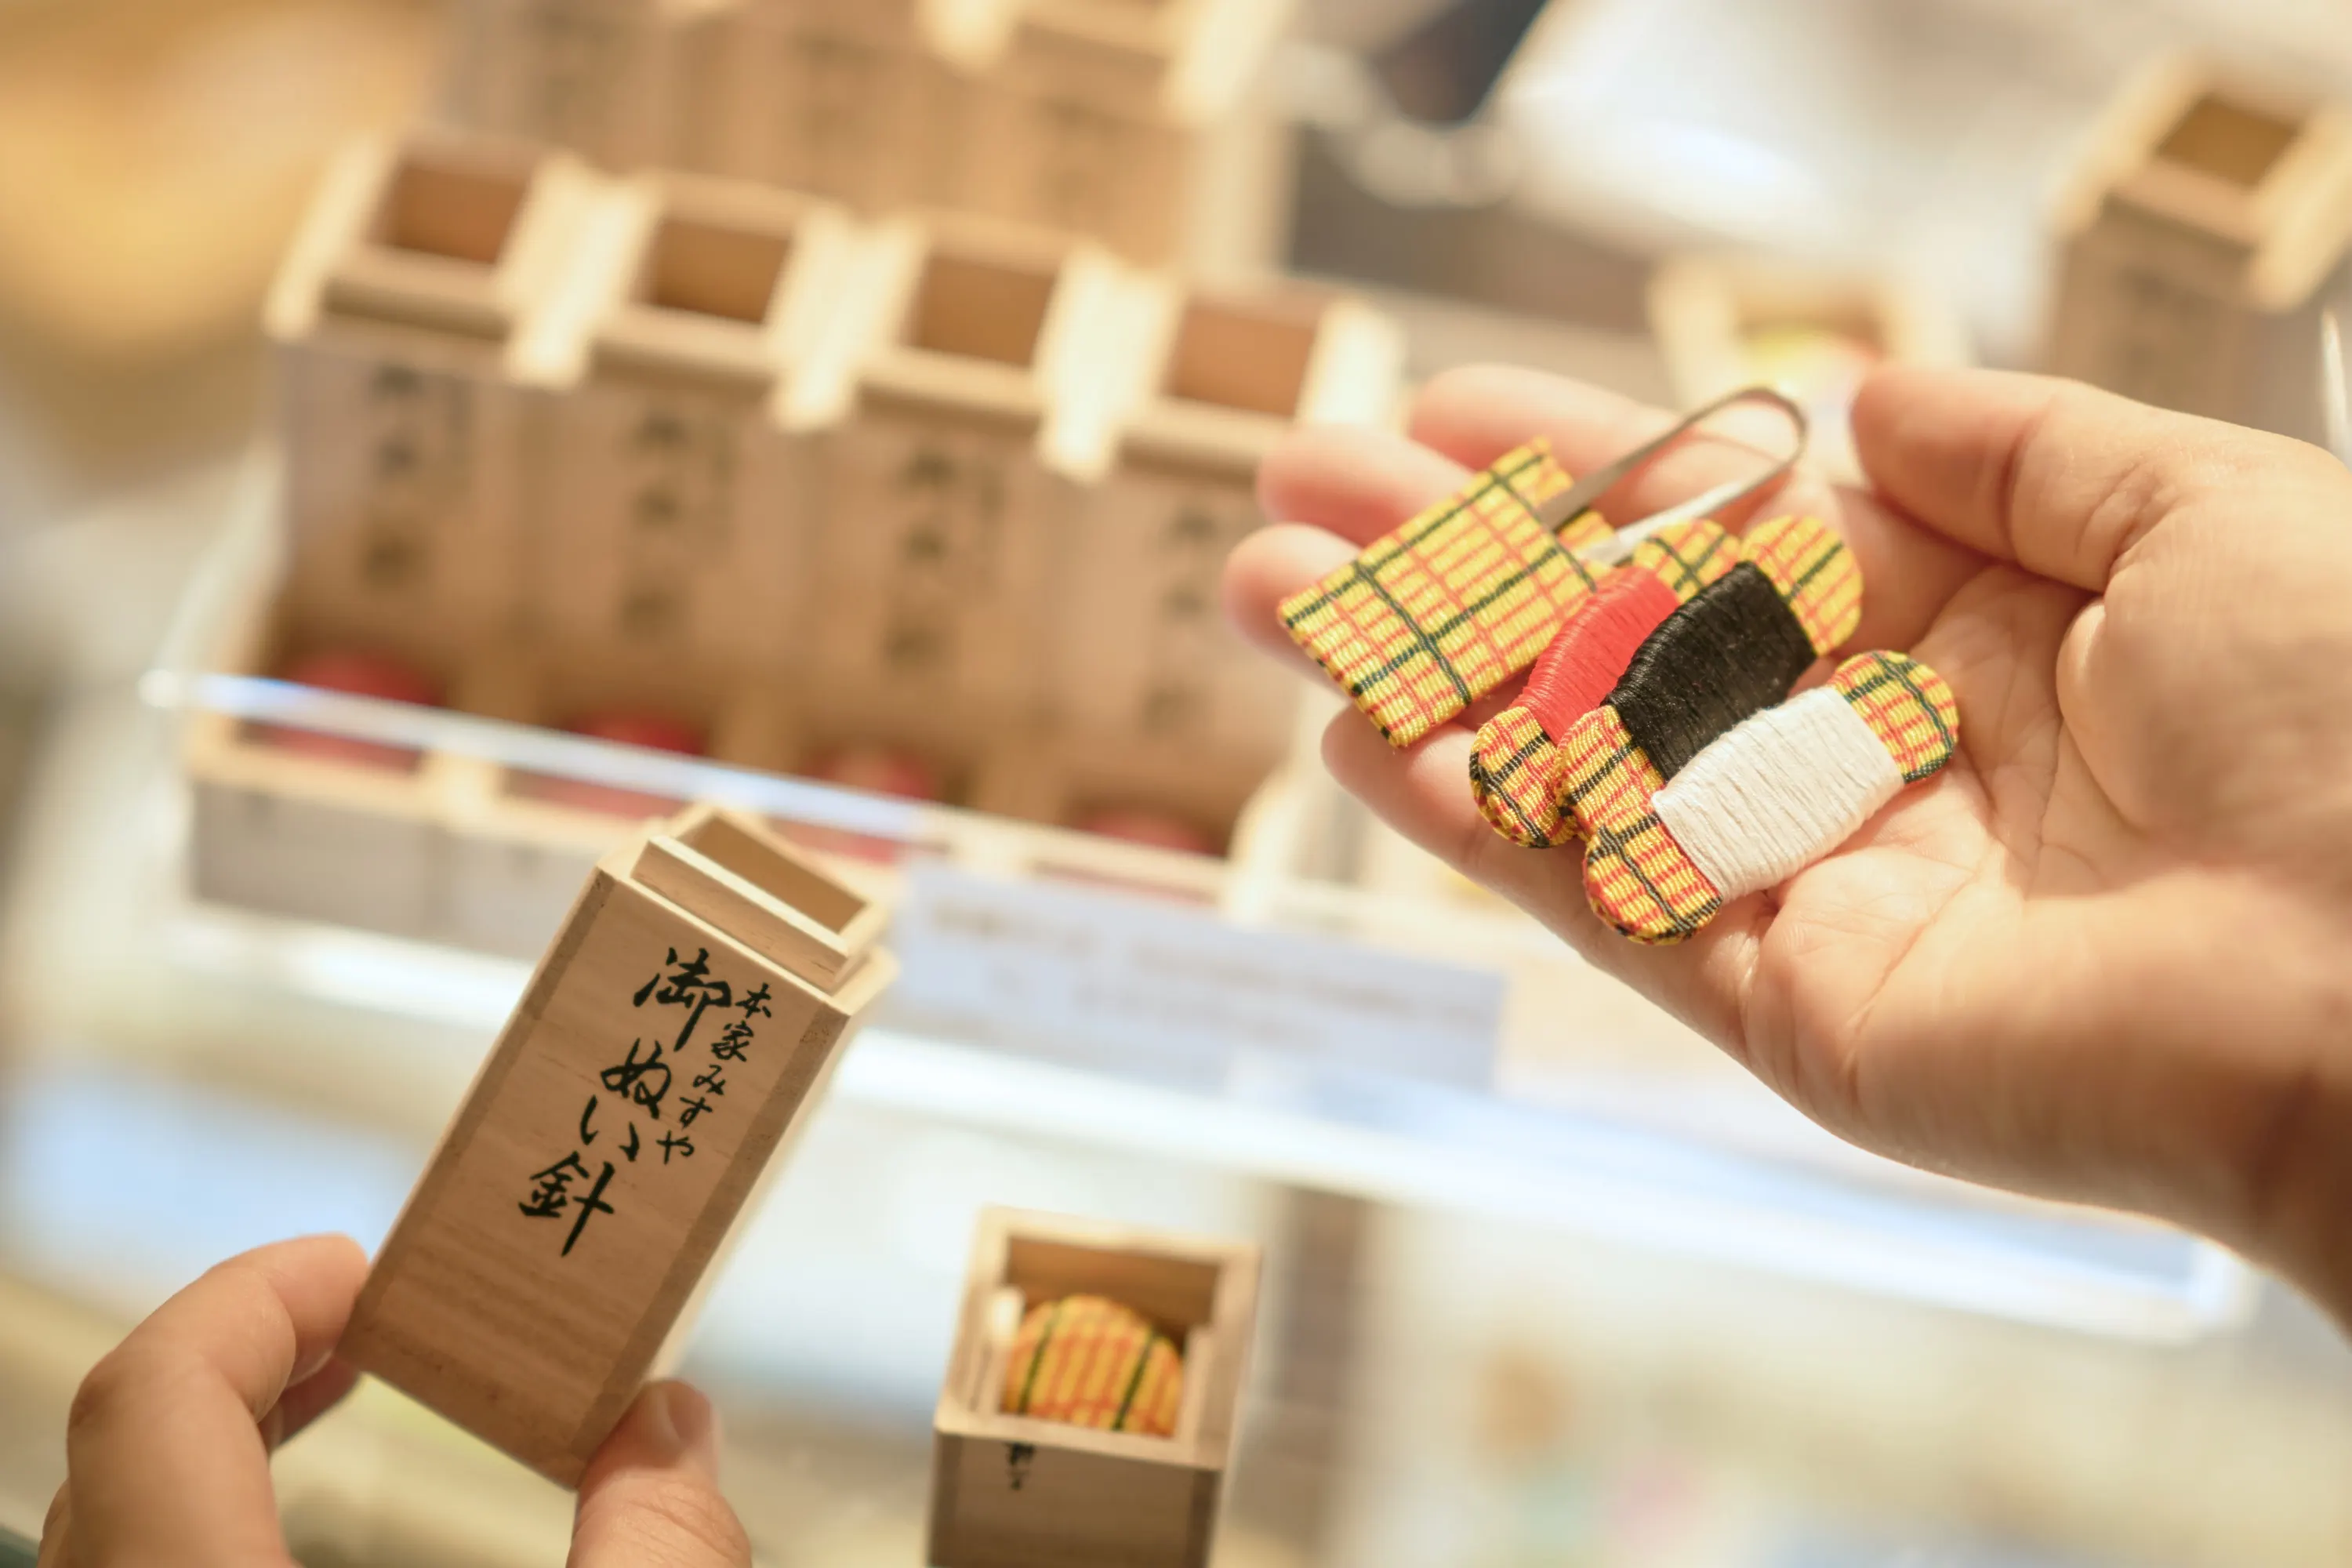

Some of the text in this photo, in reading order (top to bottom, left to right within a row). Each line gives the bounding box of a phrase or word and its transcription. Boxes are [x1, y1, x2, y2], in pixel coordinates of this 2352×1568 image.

[518, 947, 731, 1258] 御ぬい針
[656, 982, 772, 1165] 本家みすや
